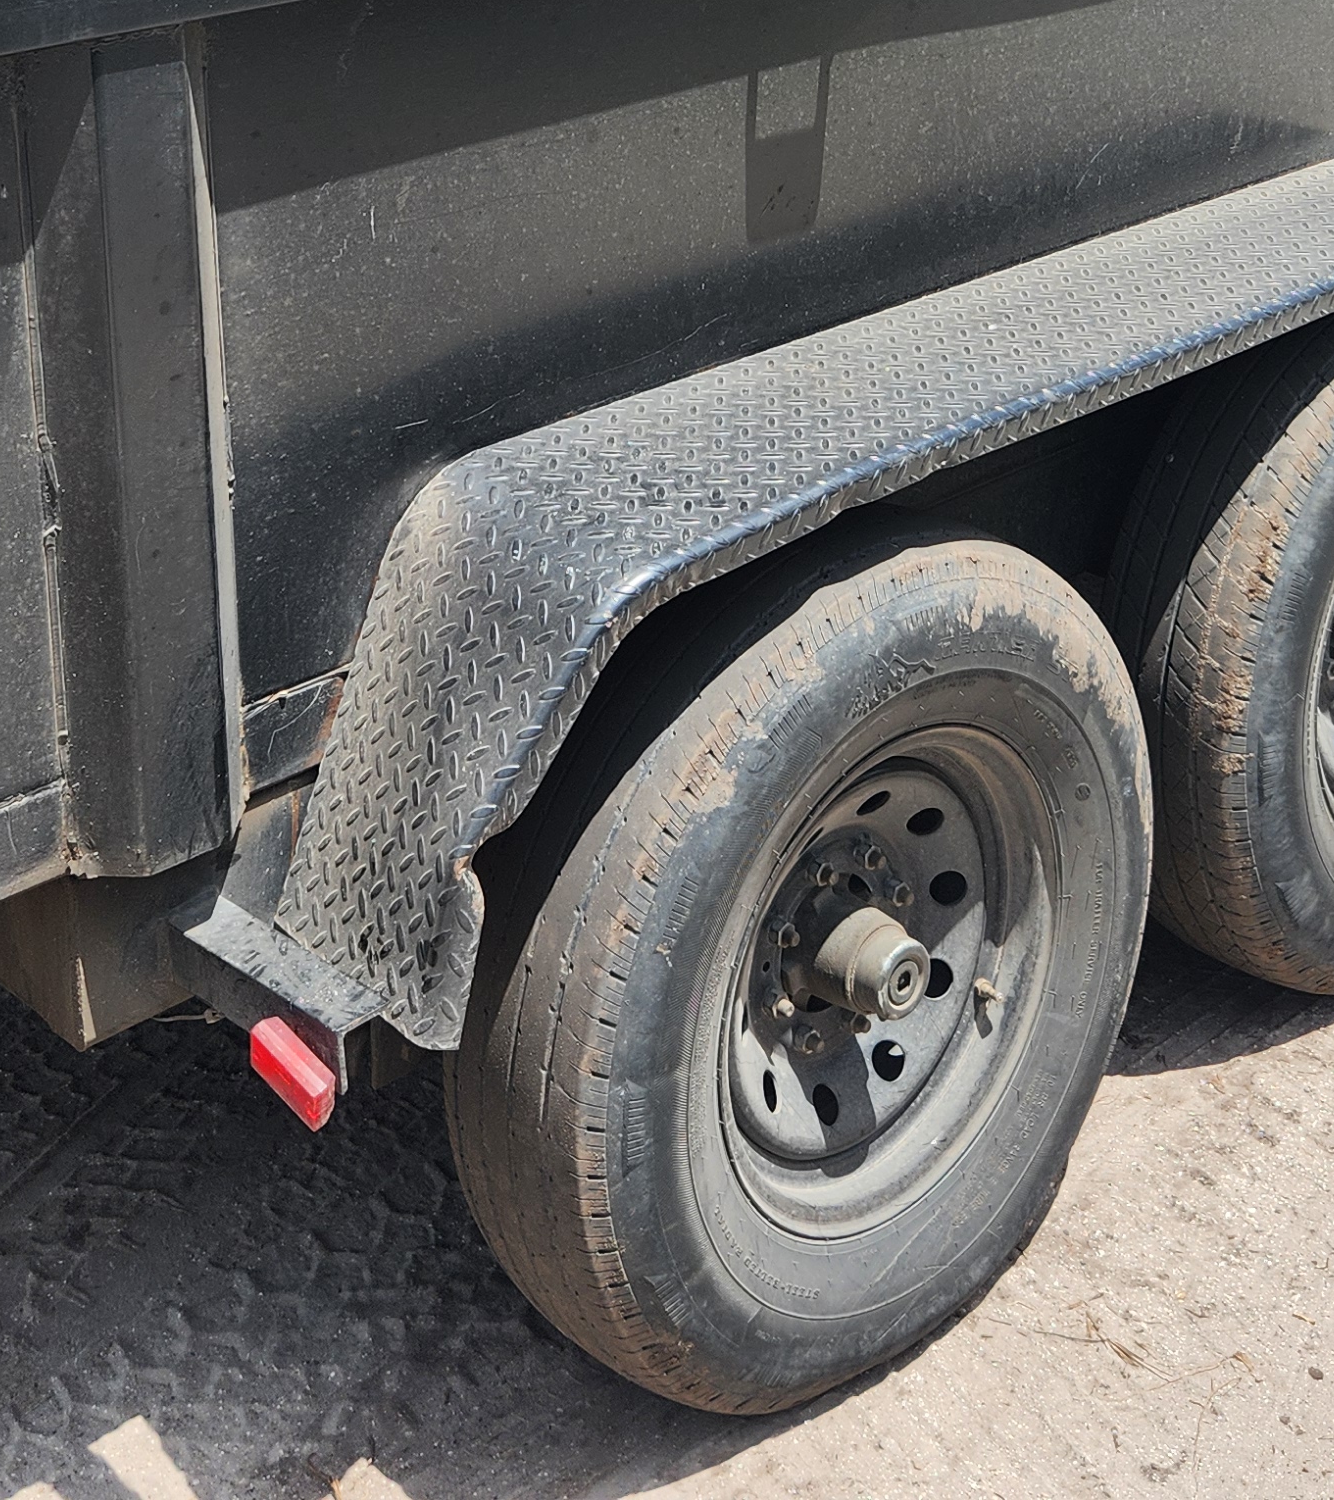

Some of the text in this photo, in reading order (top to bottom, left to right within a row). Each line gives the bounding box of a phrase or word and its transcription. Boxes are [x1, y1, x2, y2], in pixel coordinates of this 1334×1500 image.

[1084, 939, 1097, 983] SERVICE
[1075, 991, 1088, 1018] ONLY
[1020, 1112, 1040, 1139] LOAD
[744, 1255, 820, 1299] STEEL-BELTED
